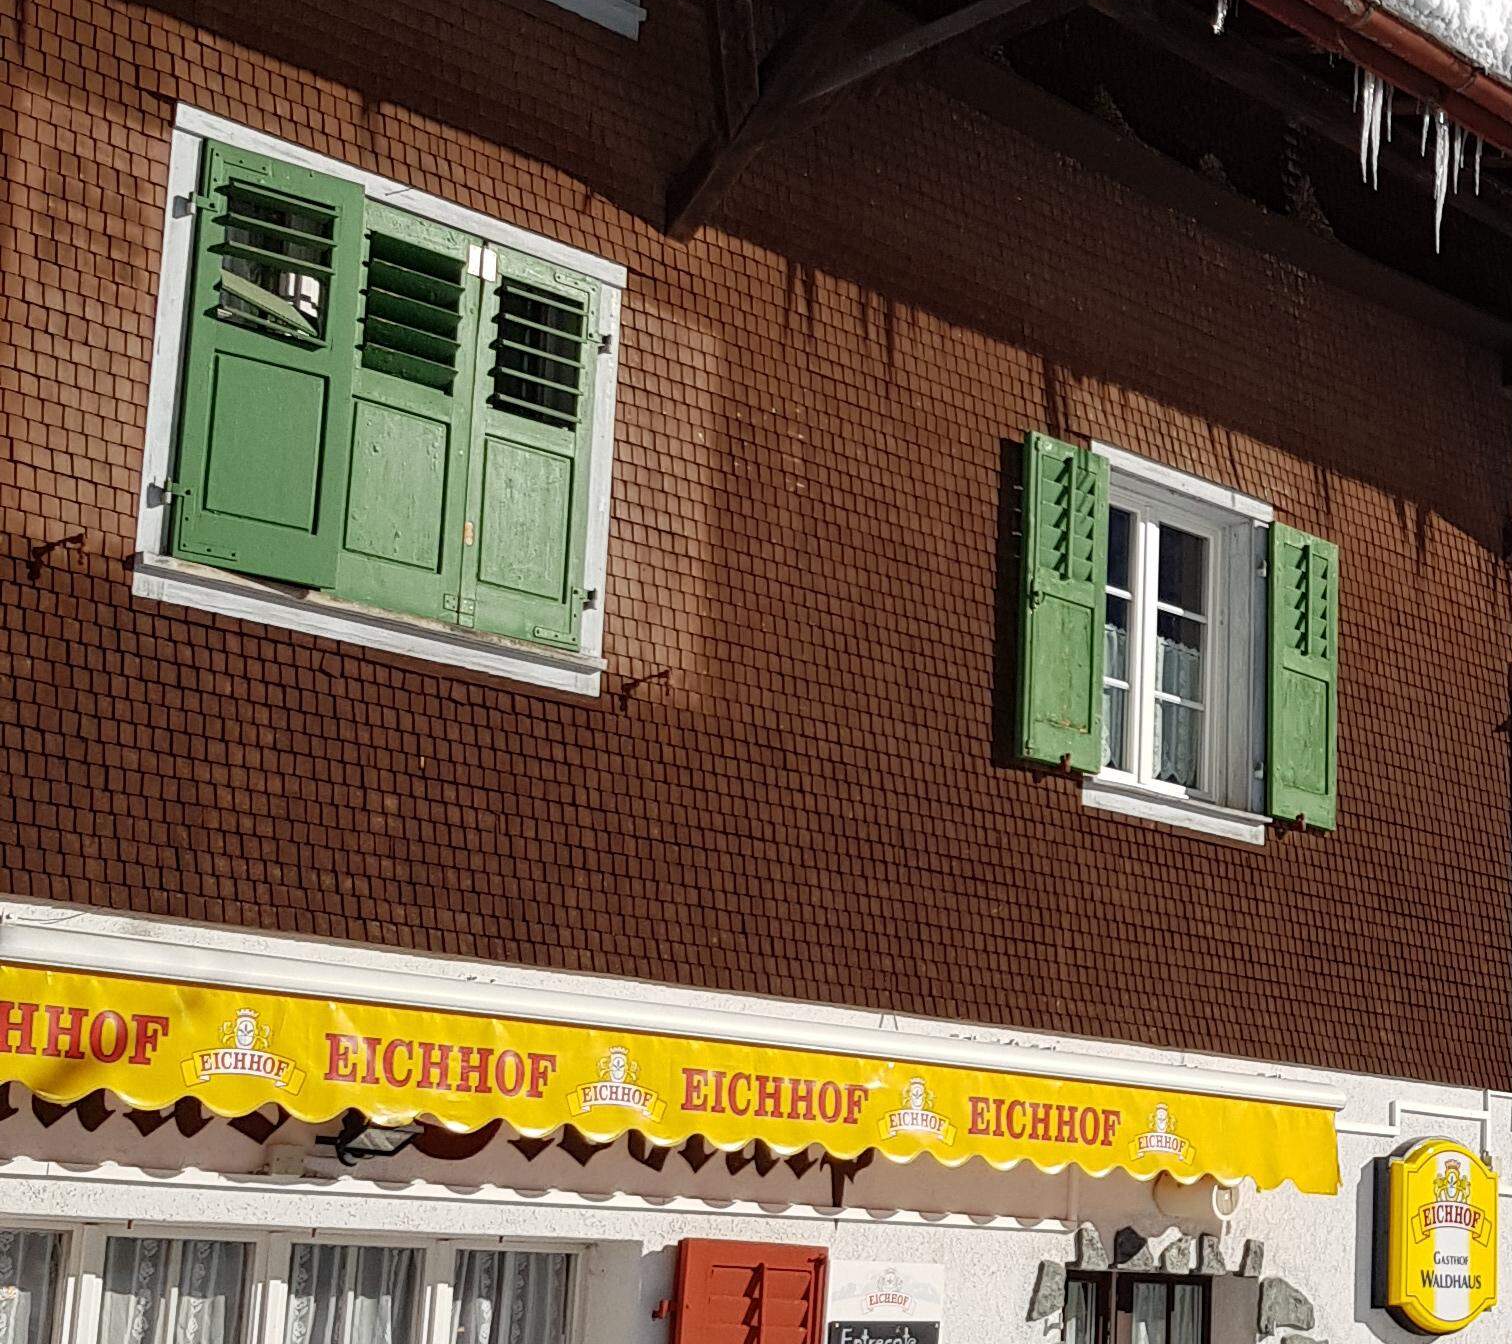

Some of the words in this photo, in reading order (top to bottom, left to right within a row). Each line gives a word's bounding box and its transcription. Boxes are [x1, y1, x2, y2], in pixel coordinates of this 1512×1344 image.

[198, 1051, 290, 1077] EICHHOF
[324, 1032, 557, 1098] EICHHOF
[581, 1084, 653, 1107] EICHHOF
[681, 1067, 869, 1125] EICHHOF
[889, 1111, 946, 1131] EICHHOF
[968, 1096, 1121, 1147] EICHHOF
[1138, 1134, 1186, 1153] EICHHOF
[1423, 1204, 1482, 1228] EICHHOF
[1420, 1269, 1482, 1289] WALDHAUS
